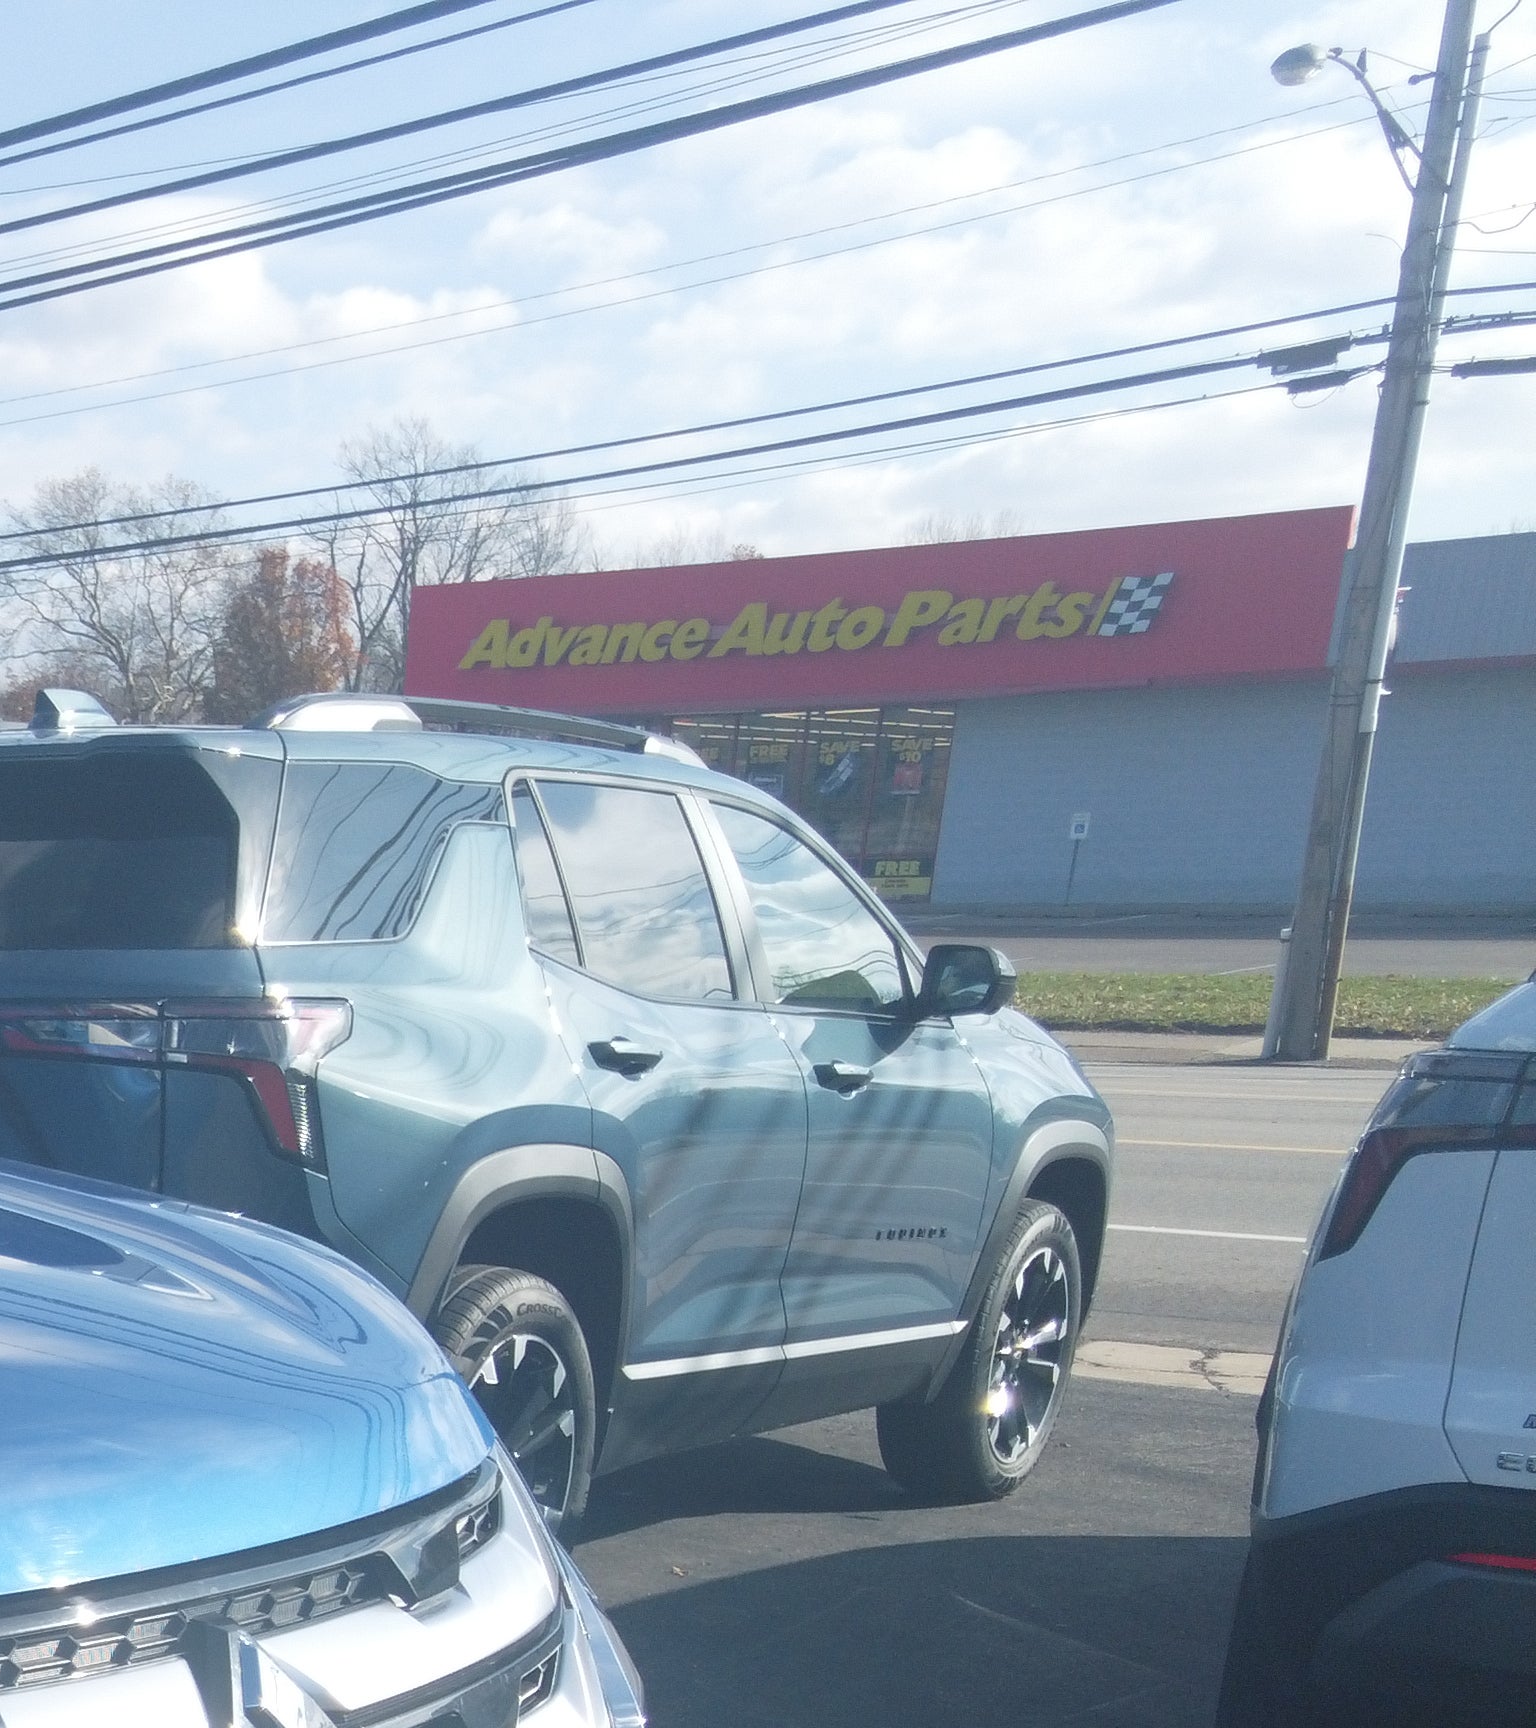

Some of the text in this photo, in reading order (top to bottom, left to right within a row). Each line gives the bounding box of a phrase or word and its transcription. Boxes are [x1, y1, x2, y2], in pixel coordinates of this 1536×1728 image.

[458, 581, 1095, 669] Advance Auto Parts
[874, 860, 921, 876] FREE
